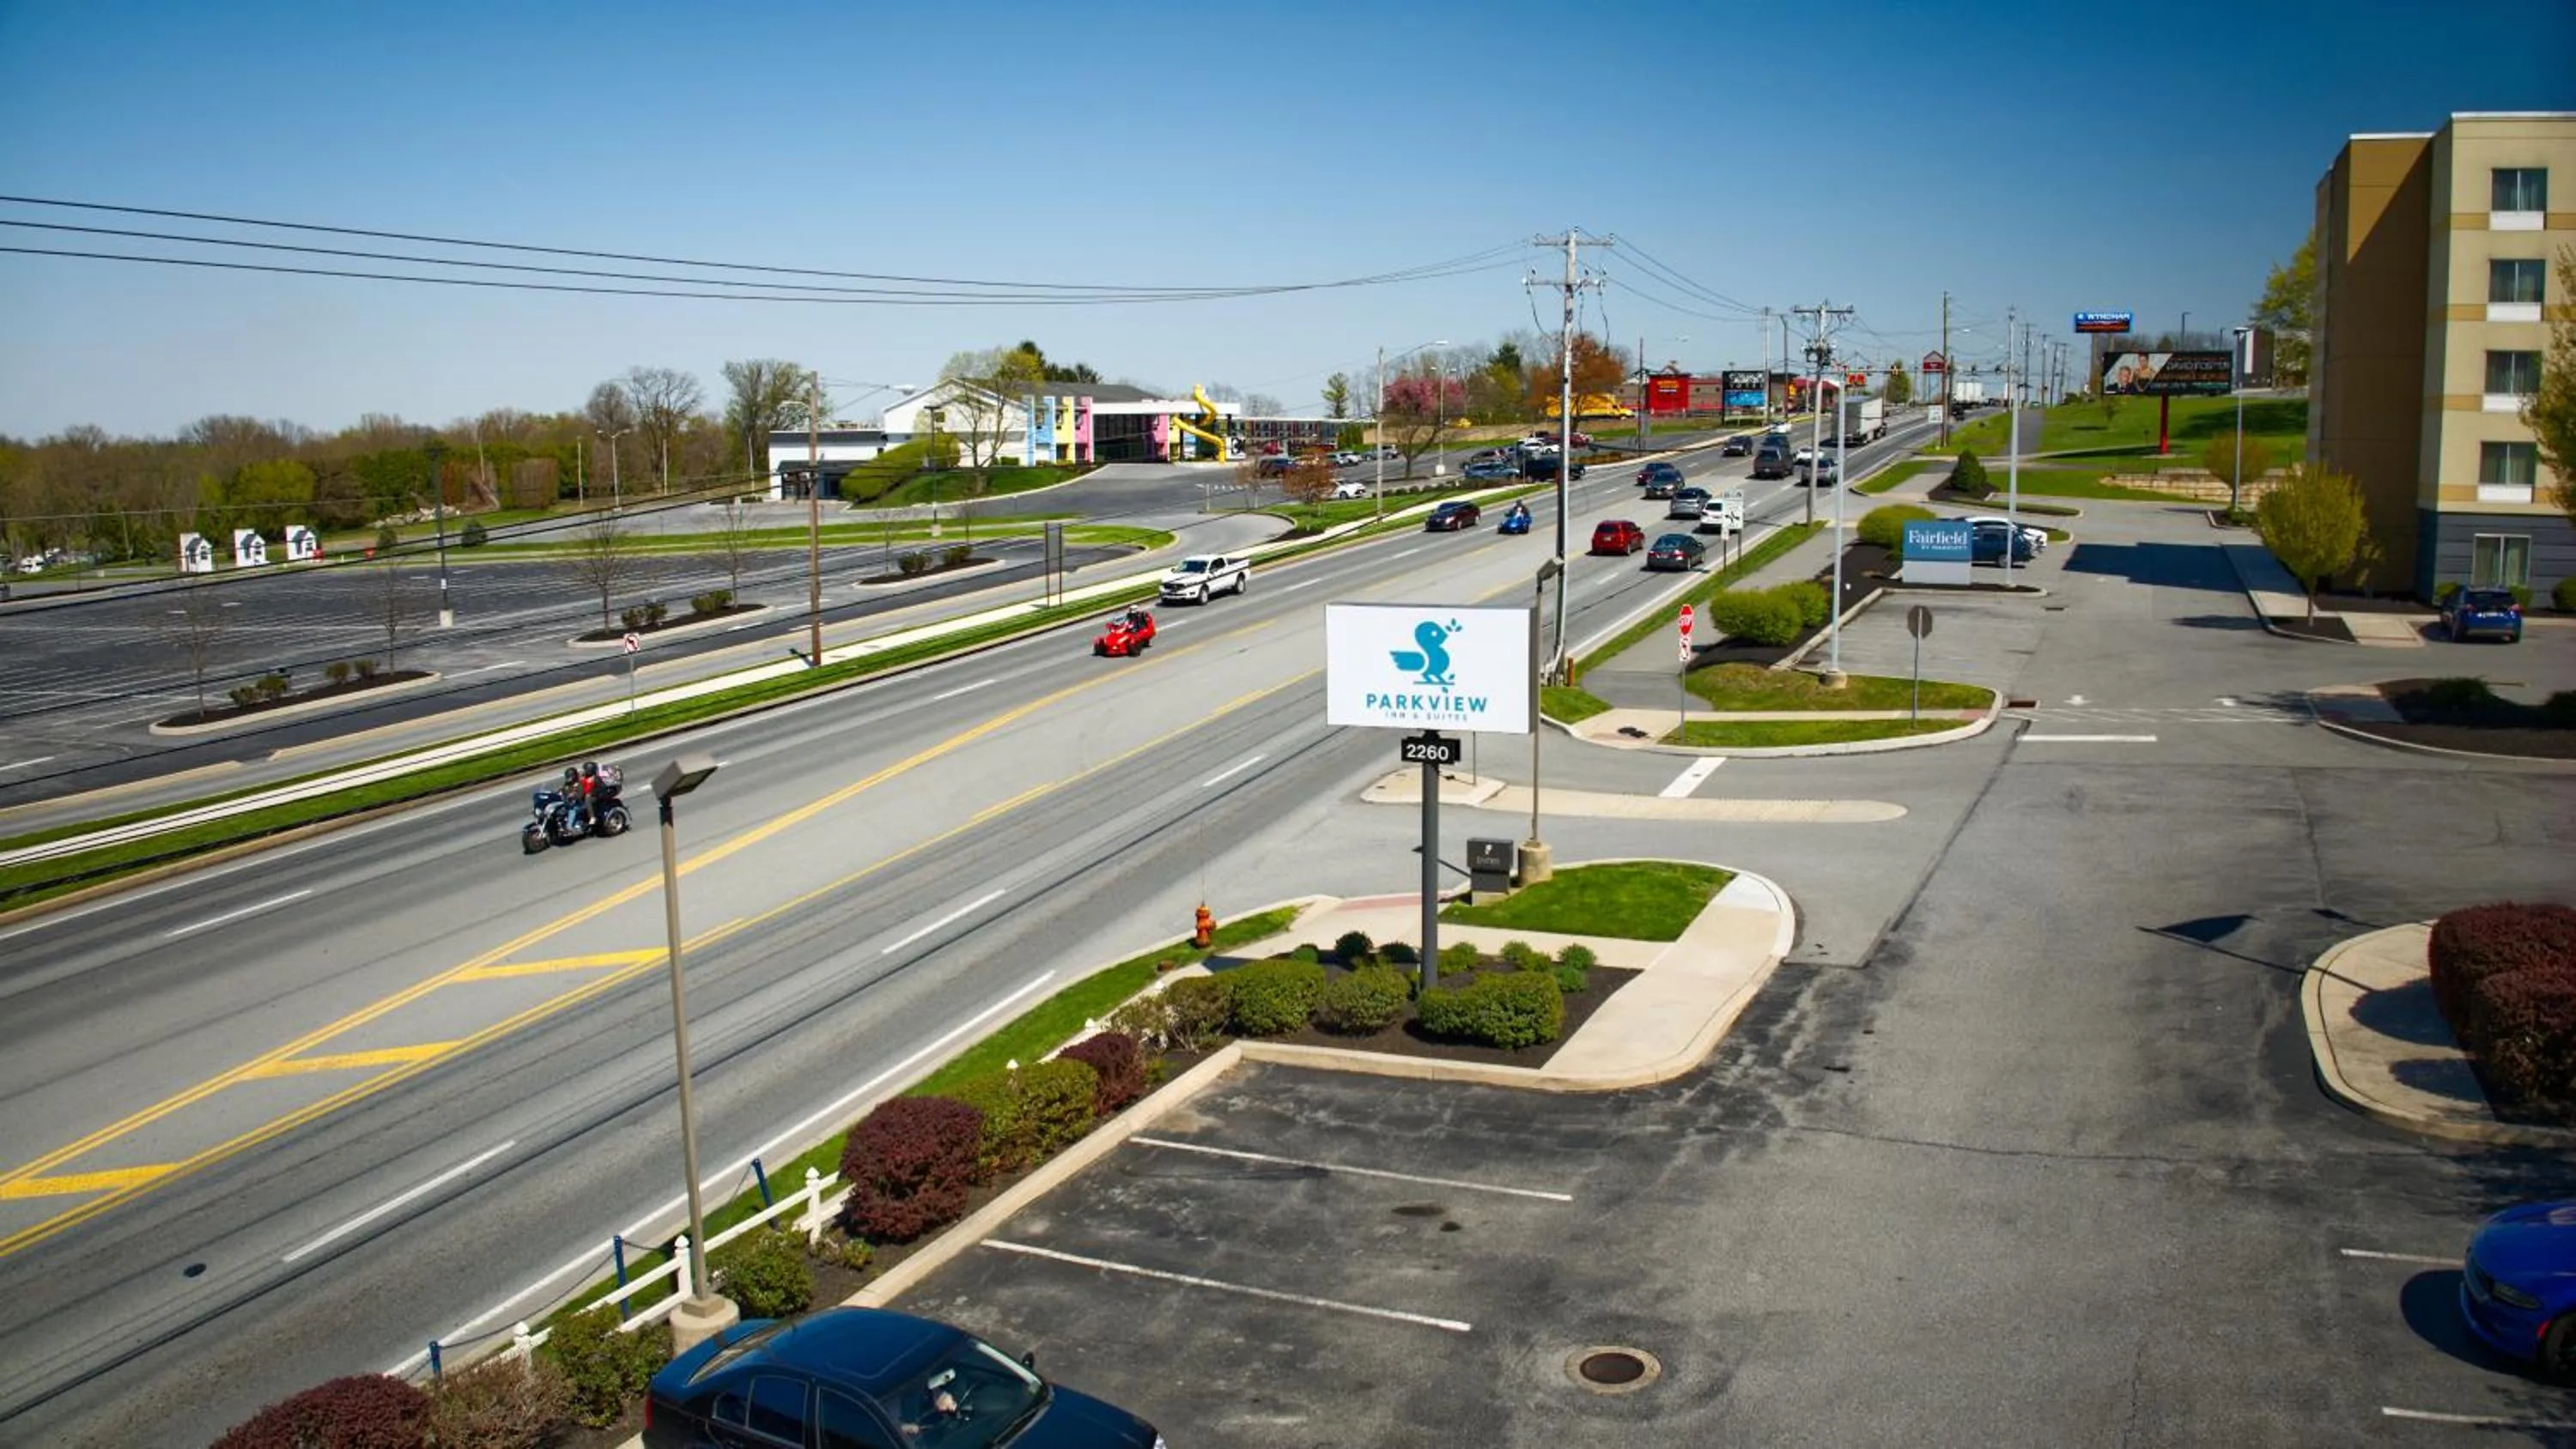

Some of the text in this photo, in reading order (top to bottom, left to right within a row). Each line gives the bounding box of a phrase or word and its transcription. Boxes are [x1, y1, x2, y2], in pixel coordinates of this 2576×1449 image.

[1909, 530, 1967, 544] Fairfield
[1366, 693, 1487, 712] PARKVIEW
[1427, 712, 1467, 721] SUITES
[1406, 744, 1449, 761] 2260
